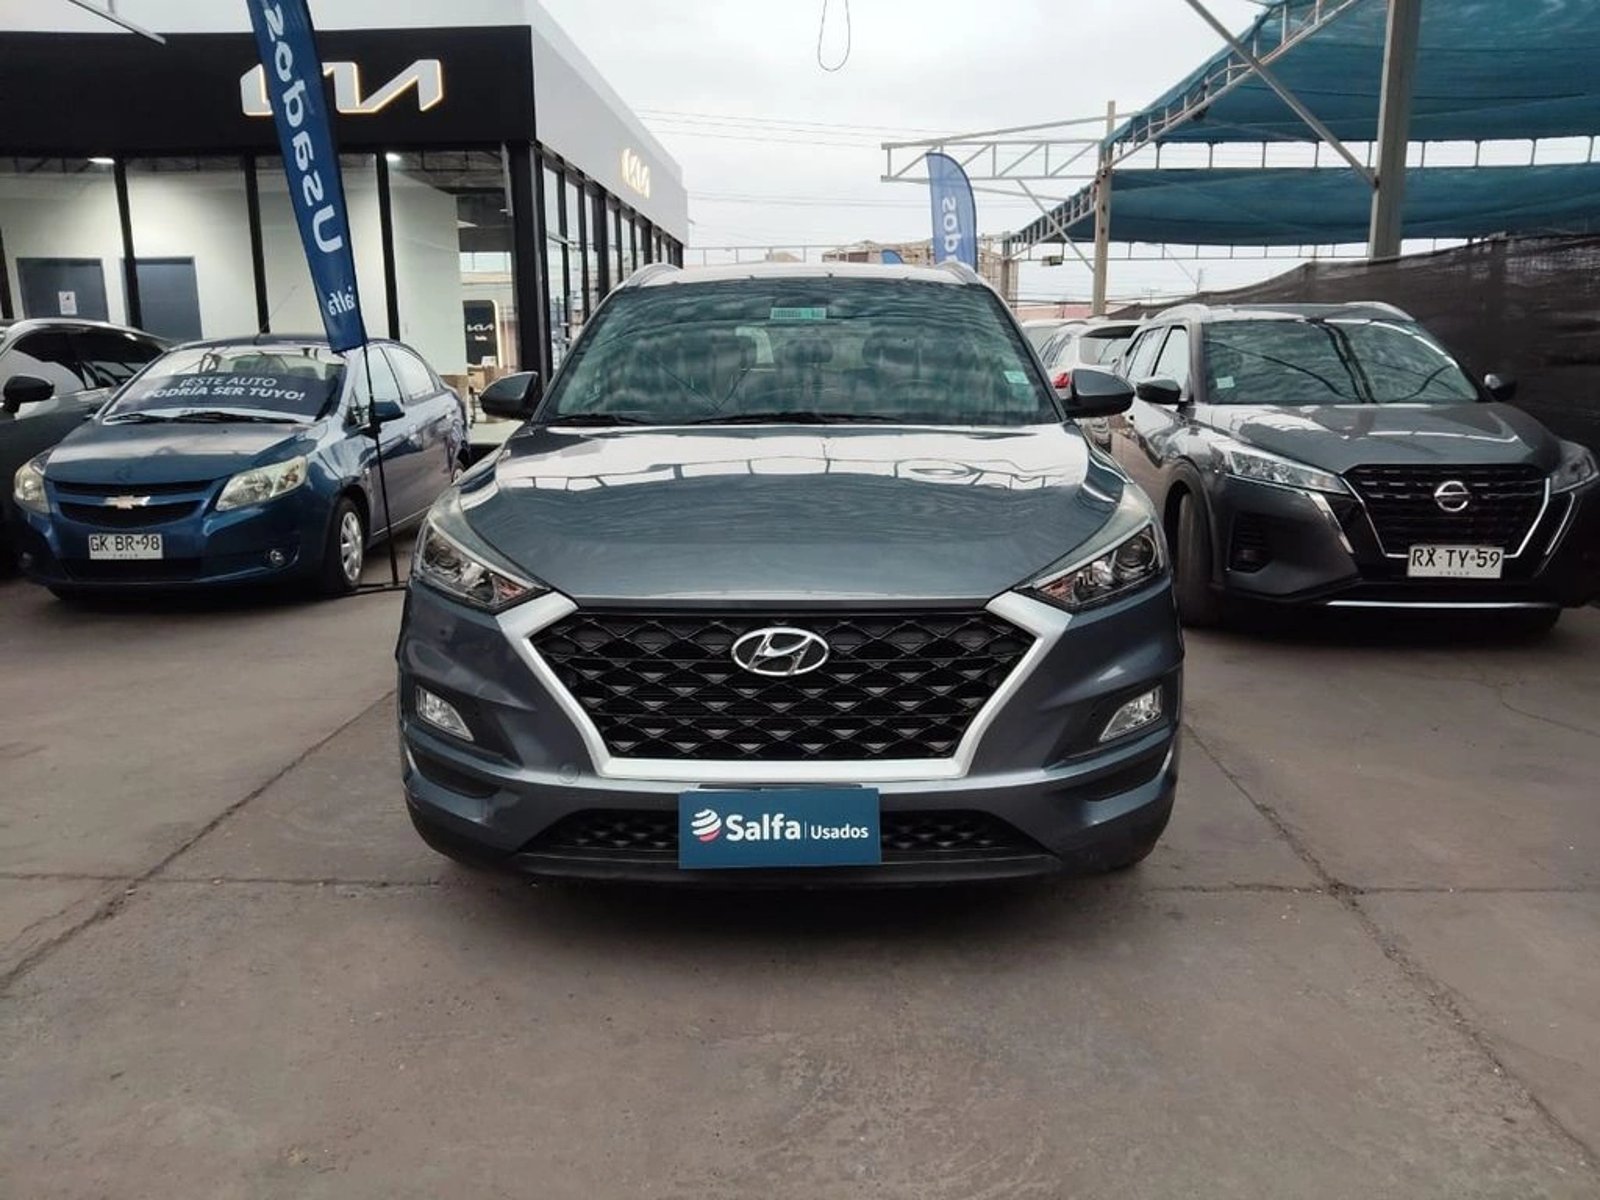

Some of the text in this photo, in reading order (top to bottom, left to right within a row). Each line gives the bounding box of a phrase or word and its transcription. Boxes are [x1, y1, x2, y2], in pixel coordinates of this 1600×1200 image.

[226, 377, 277, 387] AUTO
[211, 386, 245, 396] SER
[250, 387, 306, 400] TUYO!
[726, 813, 869, 842] Salfa Usados
